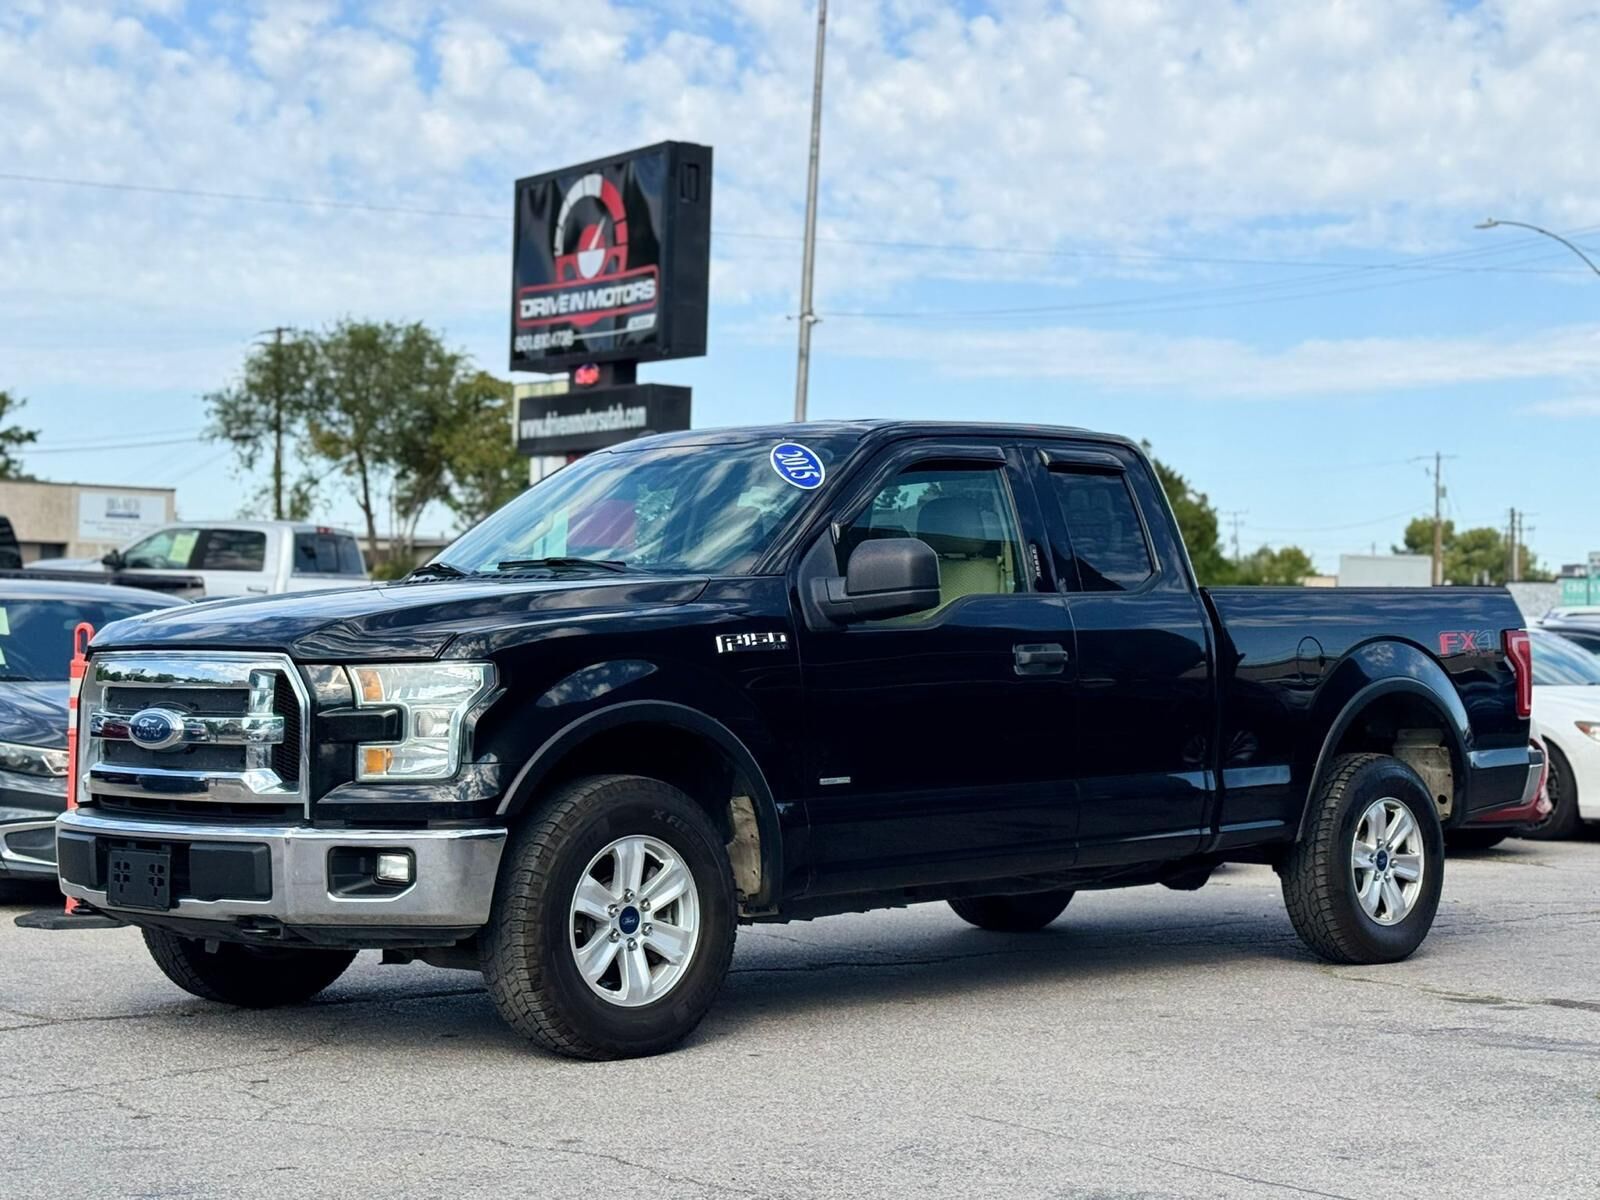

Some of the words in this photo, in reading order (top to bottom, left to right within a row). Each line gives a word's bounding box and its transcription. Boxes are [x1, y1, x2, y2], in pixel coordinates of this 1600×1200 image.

[586, 279, 657, 309] MOTORS
[775, 450, 820, 479] 2015
[1439, 629, 1496, 657] FX4
